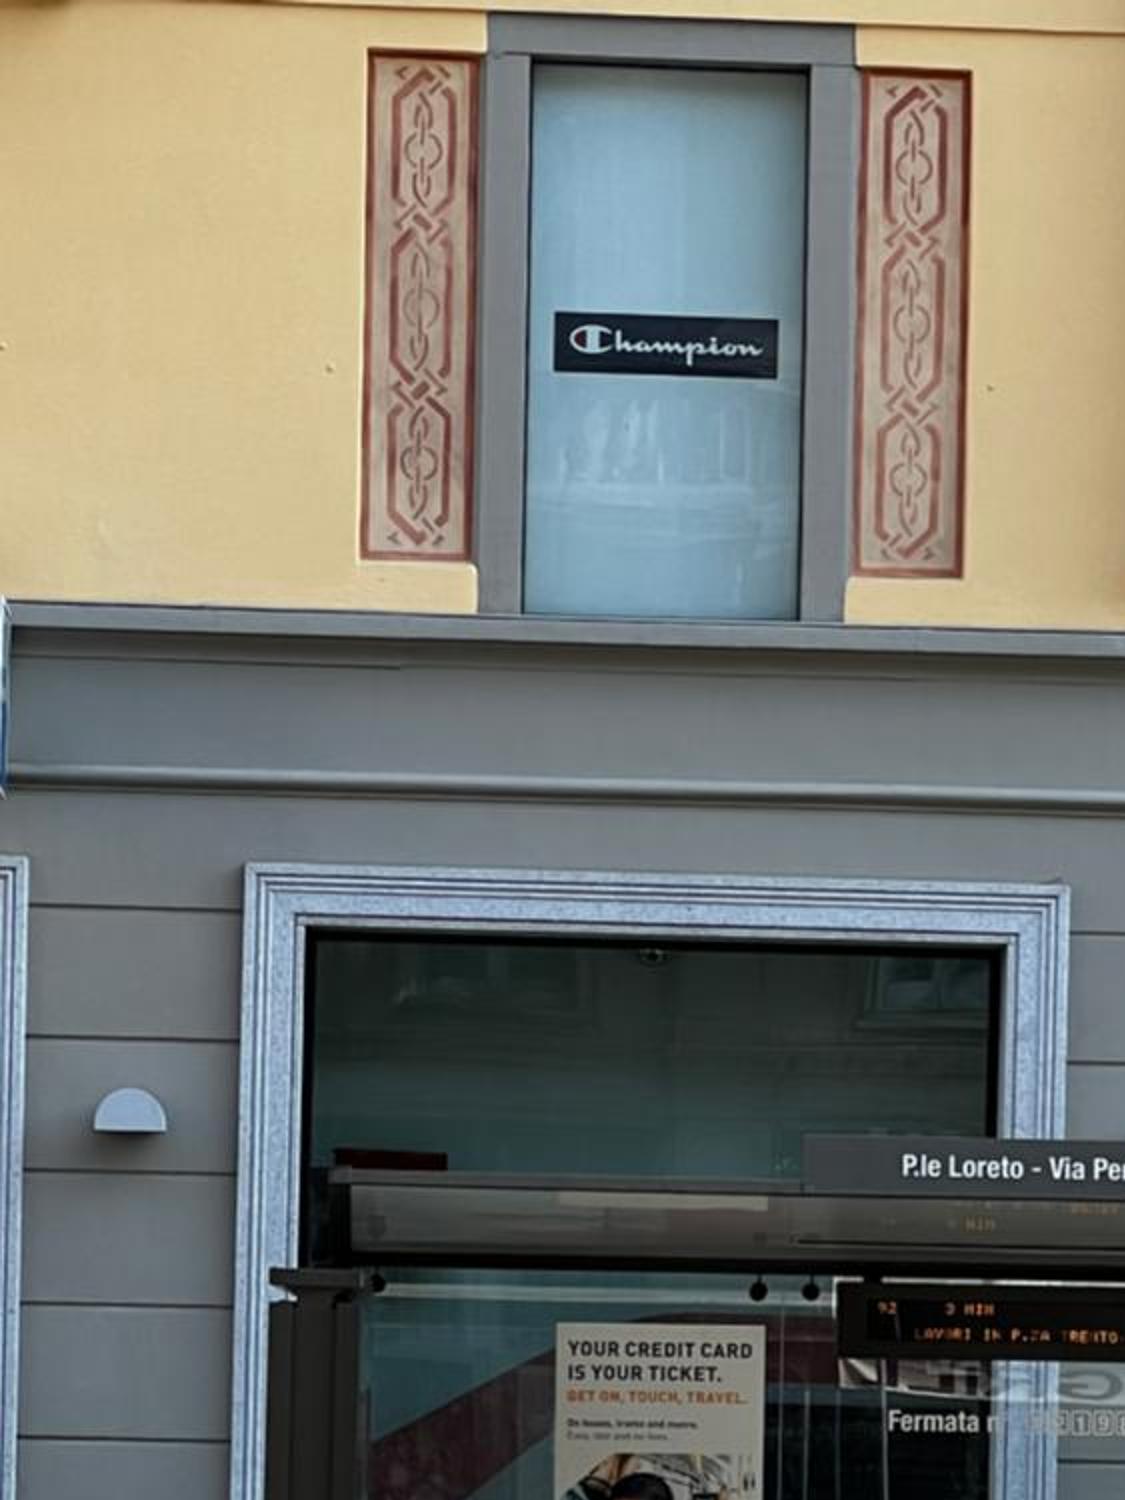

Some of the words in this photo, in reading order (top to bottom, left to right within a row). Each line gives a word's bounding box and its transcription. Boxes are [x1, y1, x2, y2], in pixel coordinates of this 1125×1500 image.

[569, 324, 764, 367] Champion
[902, 1154, 942, 1178] P.le
[949, 1155, 1025, 1180] Loreto
[1050, 1156, 1086, 1181] Via
[567, 1340, 619, 1358] YOUR
[625, 1341, 696, 1358] CREDIT
[701, 1342, 753, 1359] CARD
[567, 1364, 586, 1381] IS
[591, 1365, 643, 1381] YOUR
[648, 1365, 722, 1383] TICKET.
[567, 1389, 596, 1403] GET
[888, 1409, 981, 1433] Fermata
